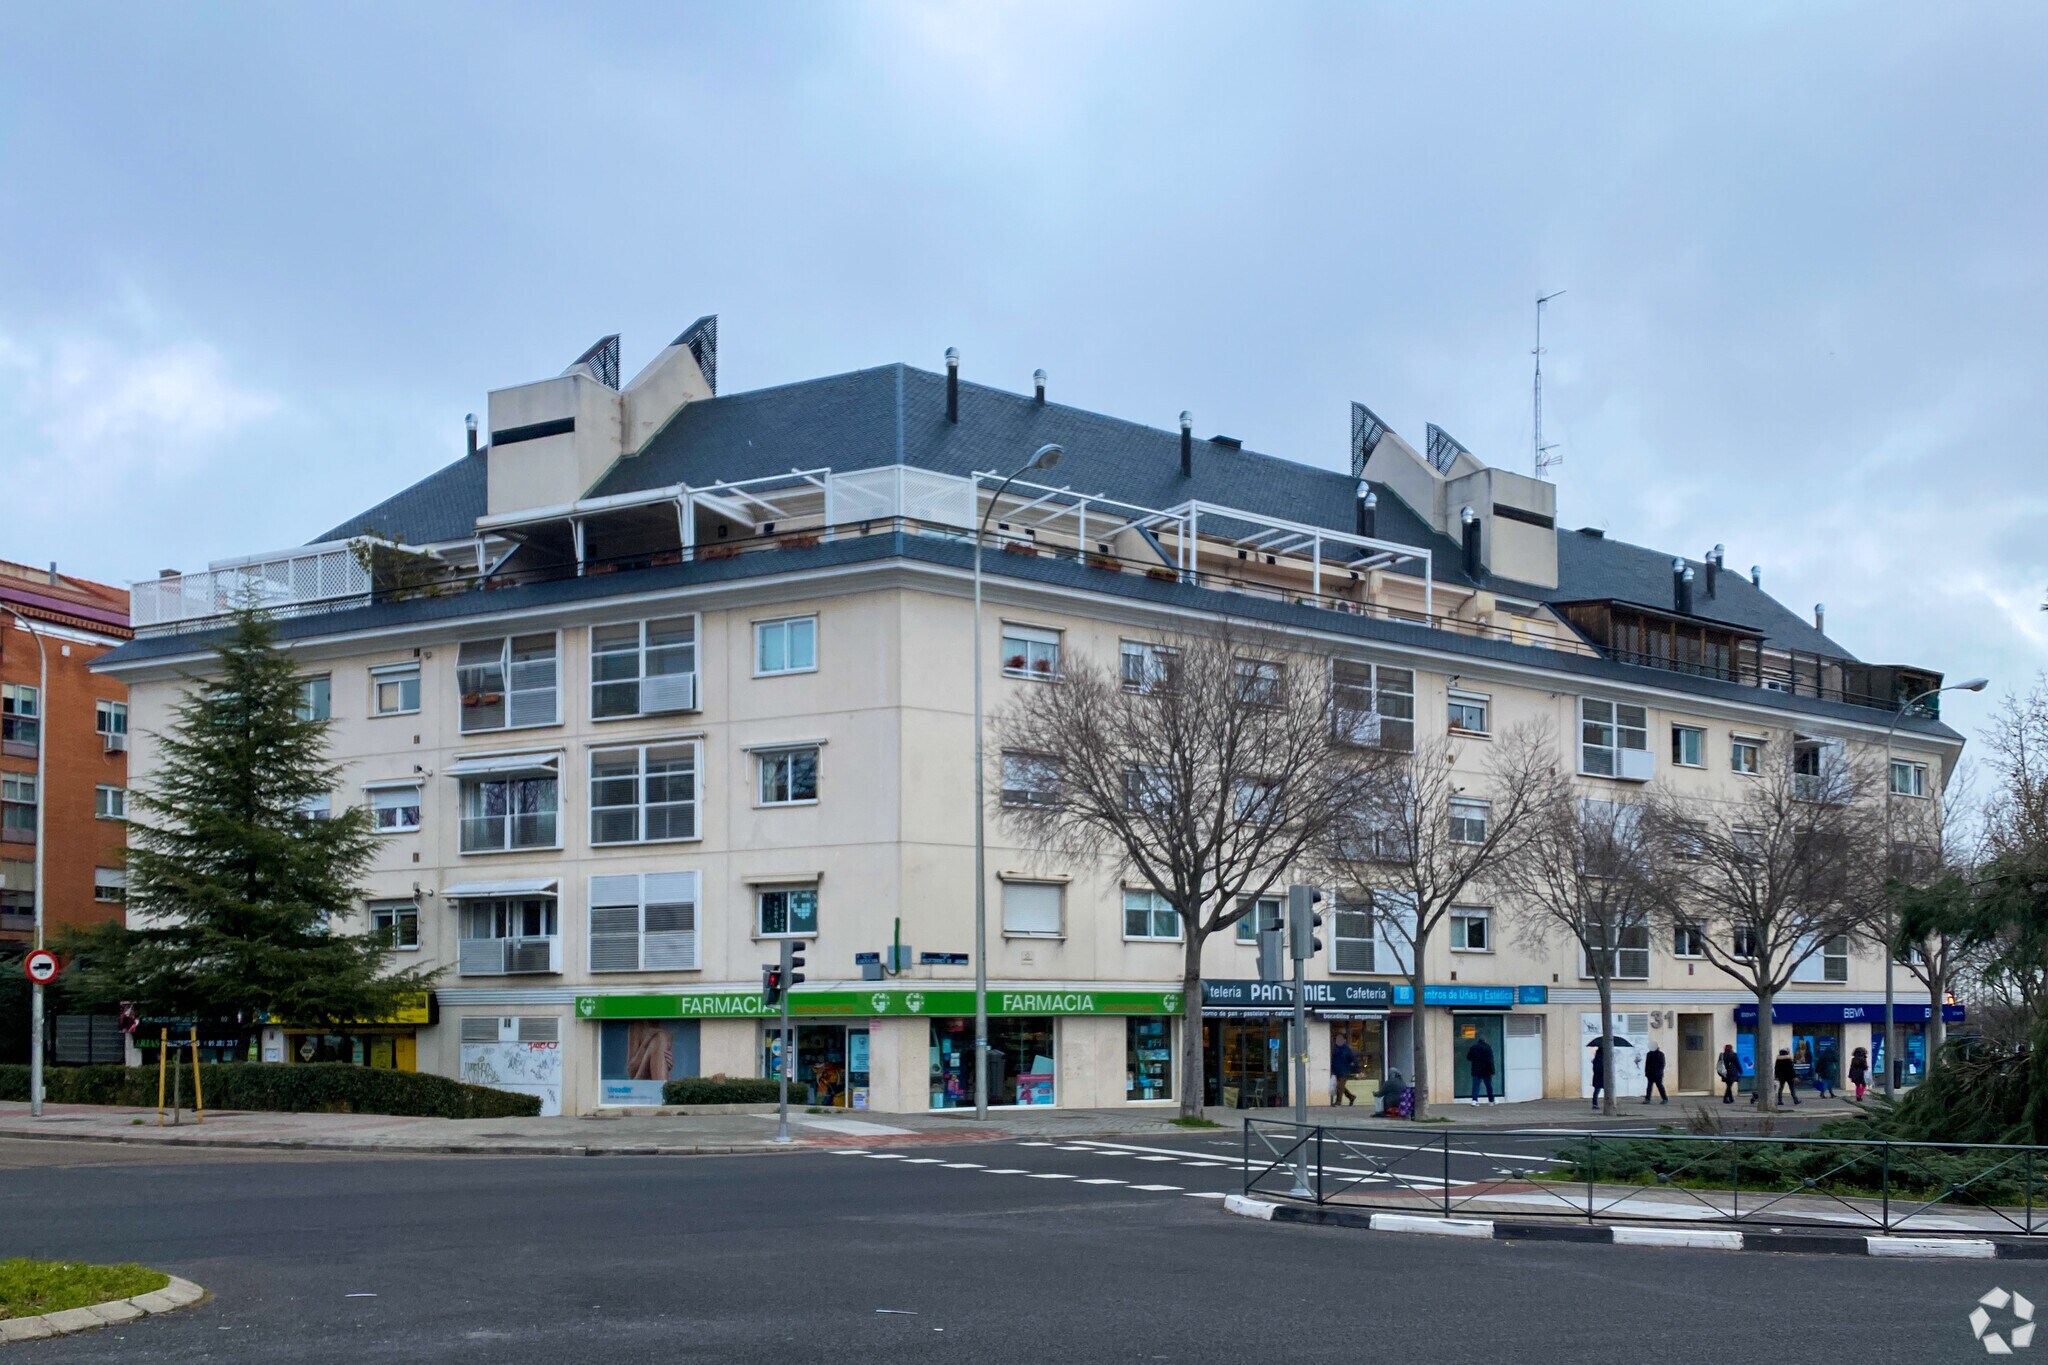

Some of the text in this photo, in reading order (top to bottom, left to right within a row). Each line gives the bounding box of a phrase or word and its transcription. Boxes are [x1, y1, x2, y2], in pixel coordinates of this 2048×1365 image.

[1210, 986, 1242, 998] telería
[1251, 984, 1282, 1001] PAN
[1346, 987, 1387, 999] Cafetería
[1424, 989, 1447, 1000] ntros
[1449, 989, 1458, 1000] de
[1460, 989, 1478, 1000] Uñas
[1479, 992, 1484, 1002] y
[1485, 989, 1514, 1001] Estética
[1003, 994, 1094, 1011] FARMACIA
[1650, 1010, 1675, 1029] 31
[1844, 1007, 1865, 1019] BBVA
